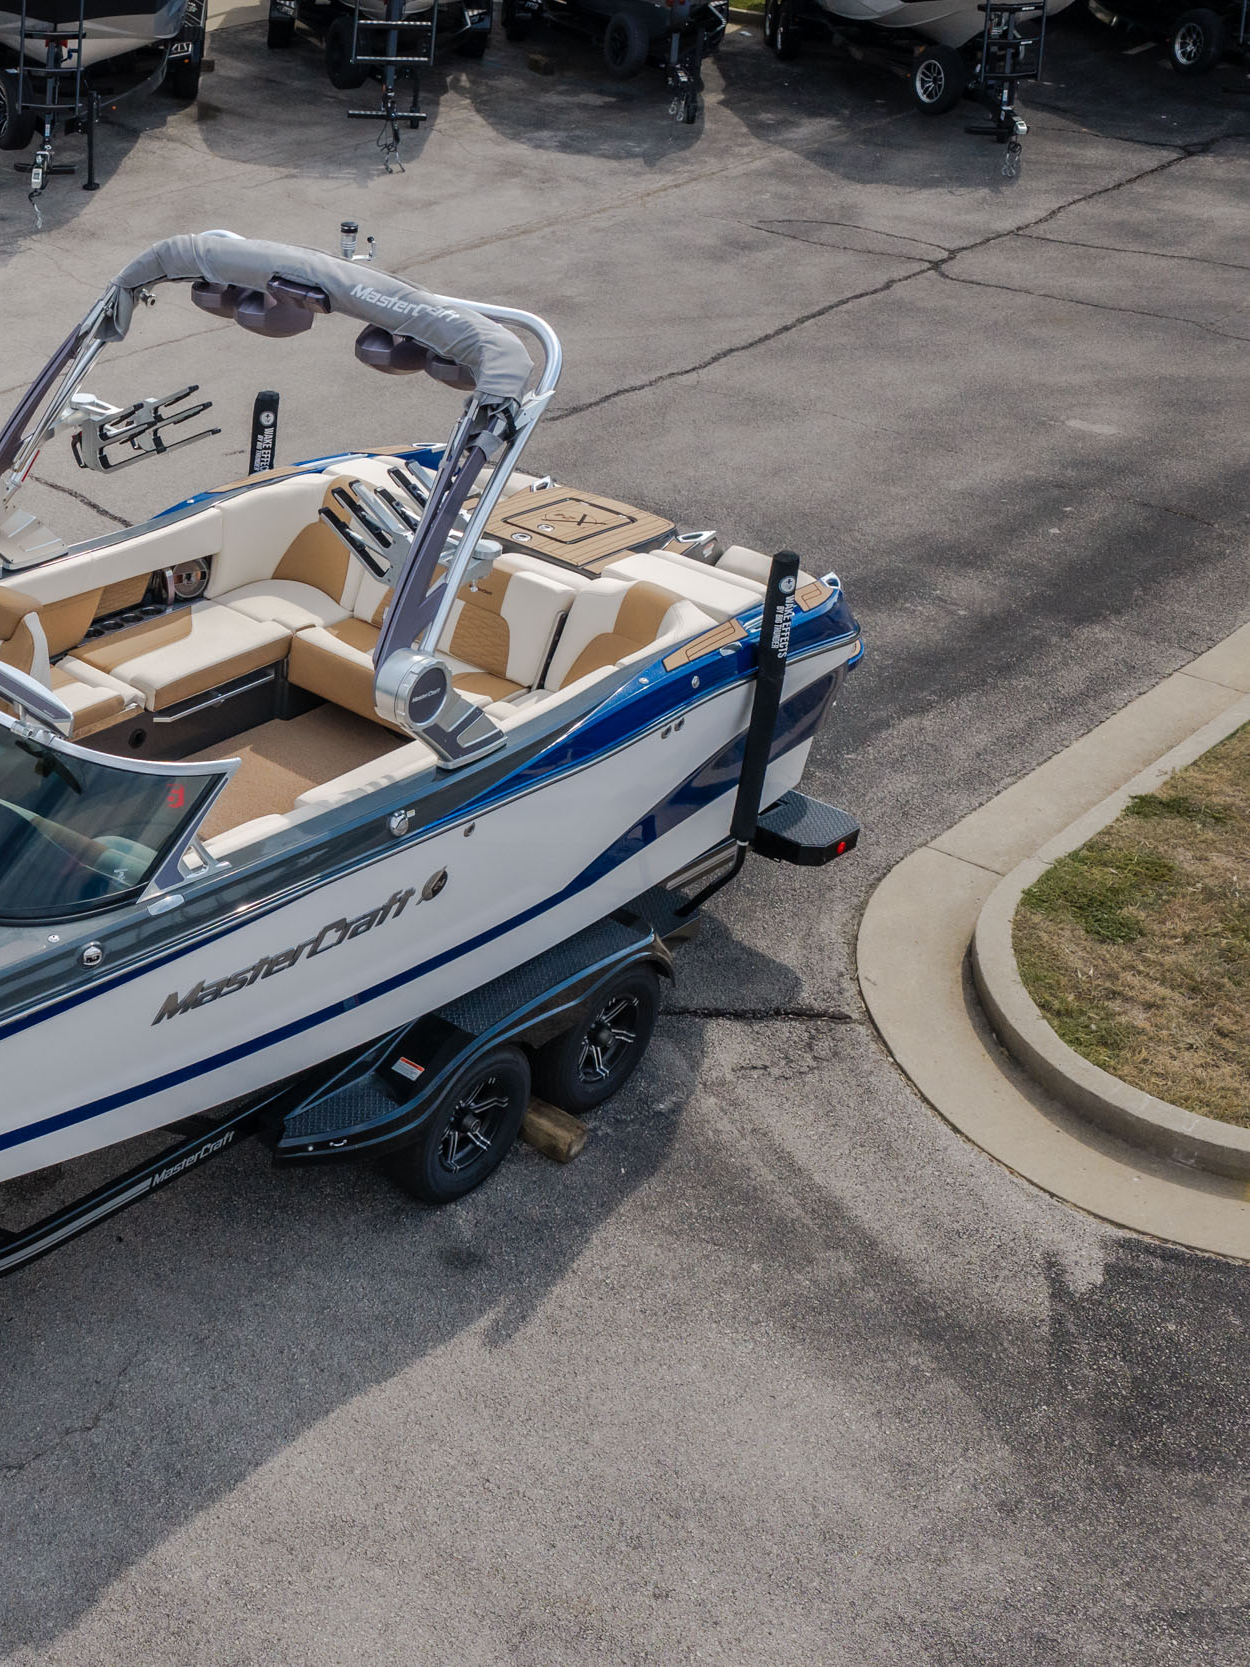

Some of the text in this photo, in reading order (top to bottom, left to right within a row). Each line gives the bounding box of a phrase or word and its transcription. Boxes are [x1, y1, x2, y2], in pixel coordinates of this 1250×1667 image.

[350, 283, 461, 322] MasterCraft
[259, 427, 274, 472] WAKE EFFEC
[771, 605, 785, 649] BY BIG THUNDER
[777, 594, 795, 659] WAKE EFFECTS
[150, 887, 416, 1026] MasterCraft
[152, 1131, 235, 1187] MasterCraft
